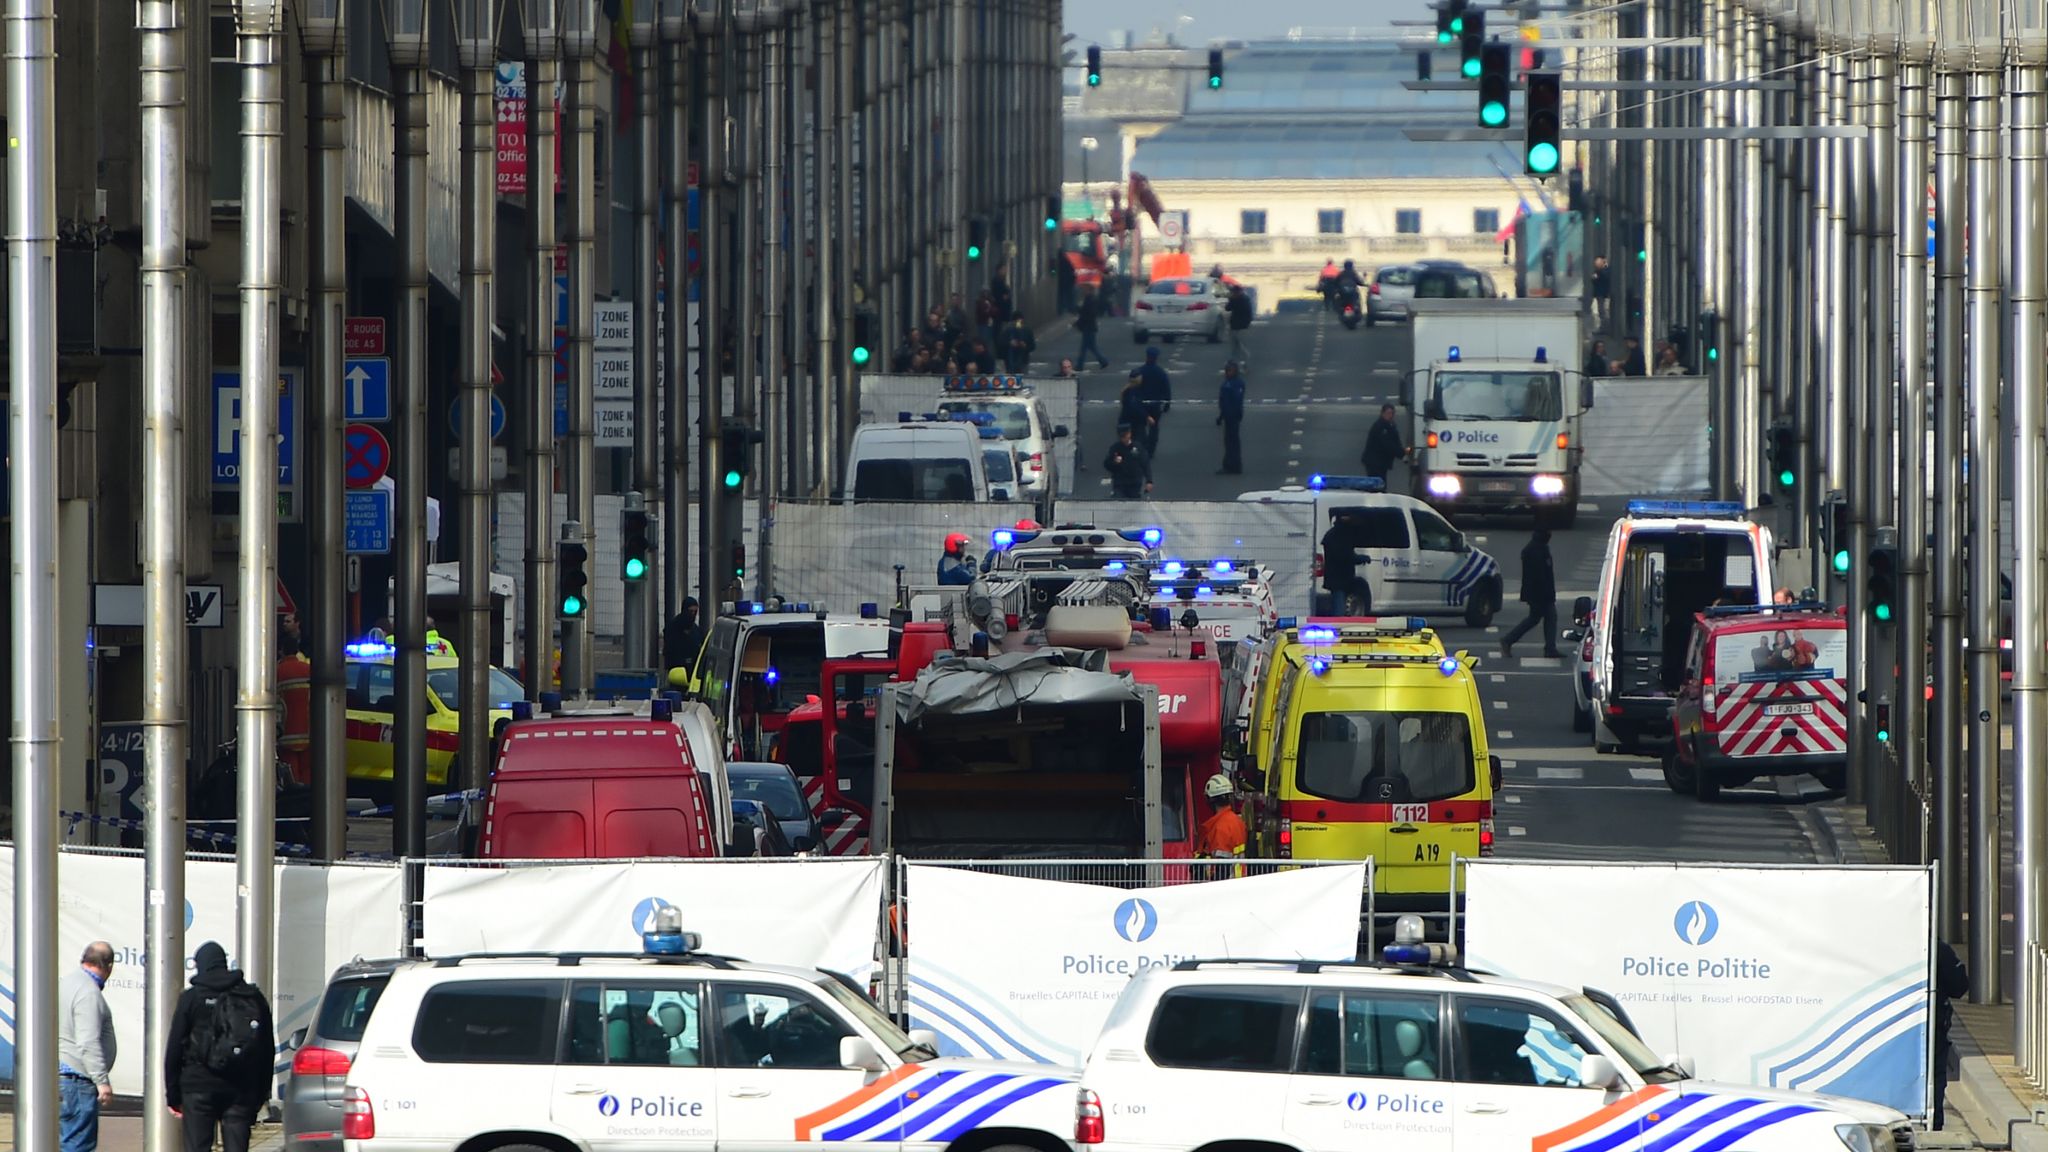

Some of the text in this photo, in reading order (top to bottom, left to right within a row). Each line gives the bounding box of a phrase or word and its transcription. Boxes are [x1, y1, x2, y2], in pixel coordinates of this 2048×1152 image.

[499, 133, 518, 146] TO
[498, 150, 526, 162] Offic
[602, 311, 628, 322] ZONE
[353, 324, 382, 334] ROUGE
[602, 328, 629, 338] ZONE
[602, 361, 629, 371] ZONE
[602, 377, 629, 388] ZONE
[602, 411, 624, 421] ZONE
[602, 427, 624, 438] ZONE
[1458, 430, 1498, 443] Police
[1158, 694, 1187, 713] ar
[1403, 805, 1427, 822] 112
[1415, 844, 1440, 861] A 19
[1063, 955, 1129, 974] Police
[1623, 956, 1771, 979] Police Politie
[1009, 991, 1053, 1001] Bruxelles
[1055, 991, 1099, 1001] CAPITALE
[398, 1100, 416, 1109] 101
[631, 1096, 703, 1117] Police
[1127, 1105, 1146, 1114] 101
[1377, 1094, 1444, 1114] Police
[607, 1126, 713, 1137] Direction Protection
[1343, 1120, 1452, 1134] Direction Protection
